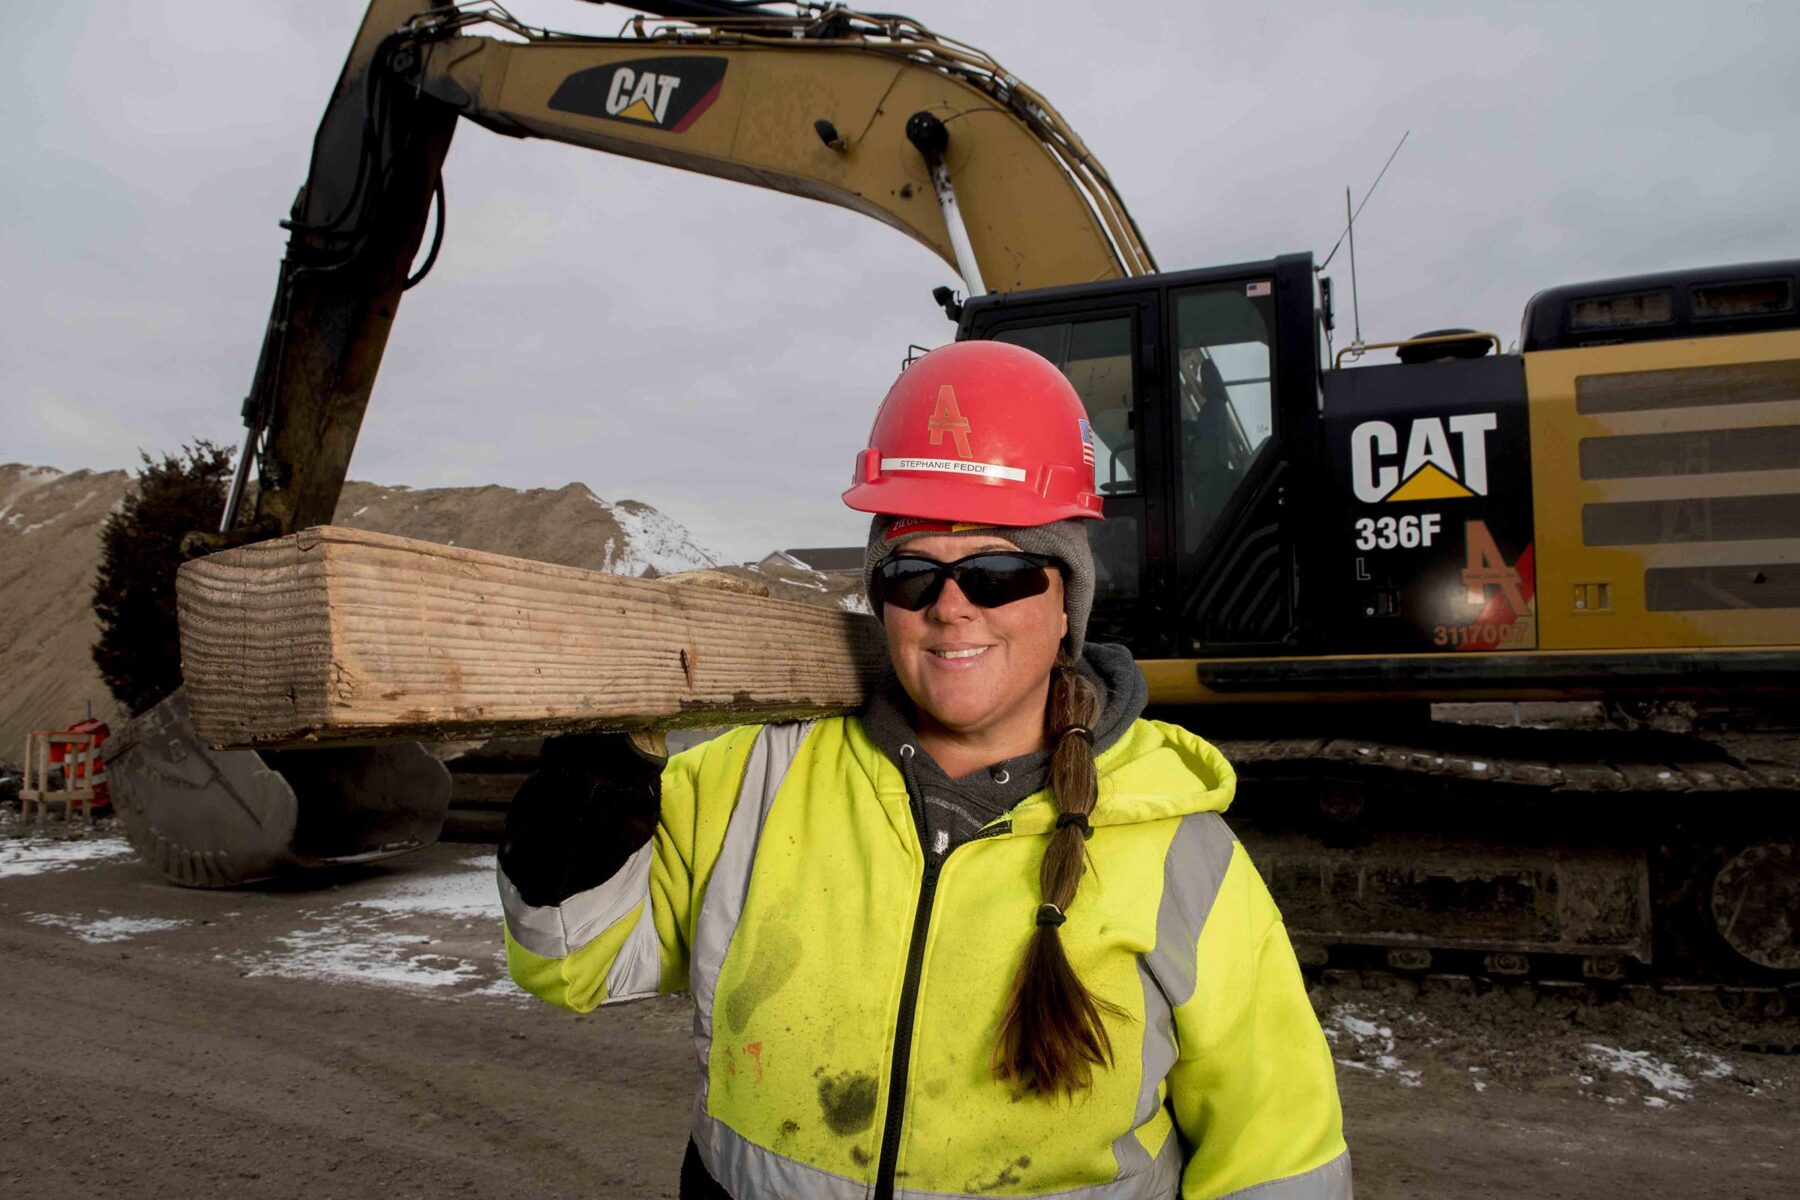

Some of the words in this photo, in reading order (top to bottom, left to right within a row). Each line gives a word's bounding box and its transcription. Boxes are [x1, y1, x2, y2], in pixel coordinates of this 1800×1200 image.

[606, 67, 680, 124] CAT
[900, 460, 951, 470] STEPHANIE
[1351, 412, 1498, 503] CAT
[1355, 513, 1441, 550] 336F
[1356, 557, 1371, 581] L
[1433, 623, 1527, 646] 3117007
